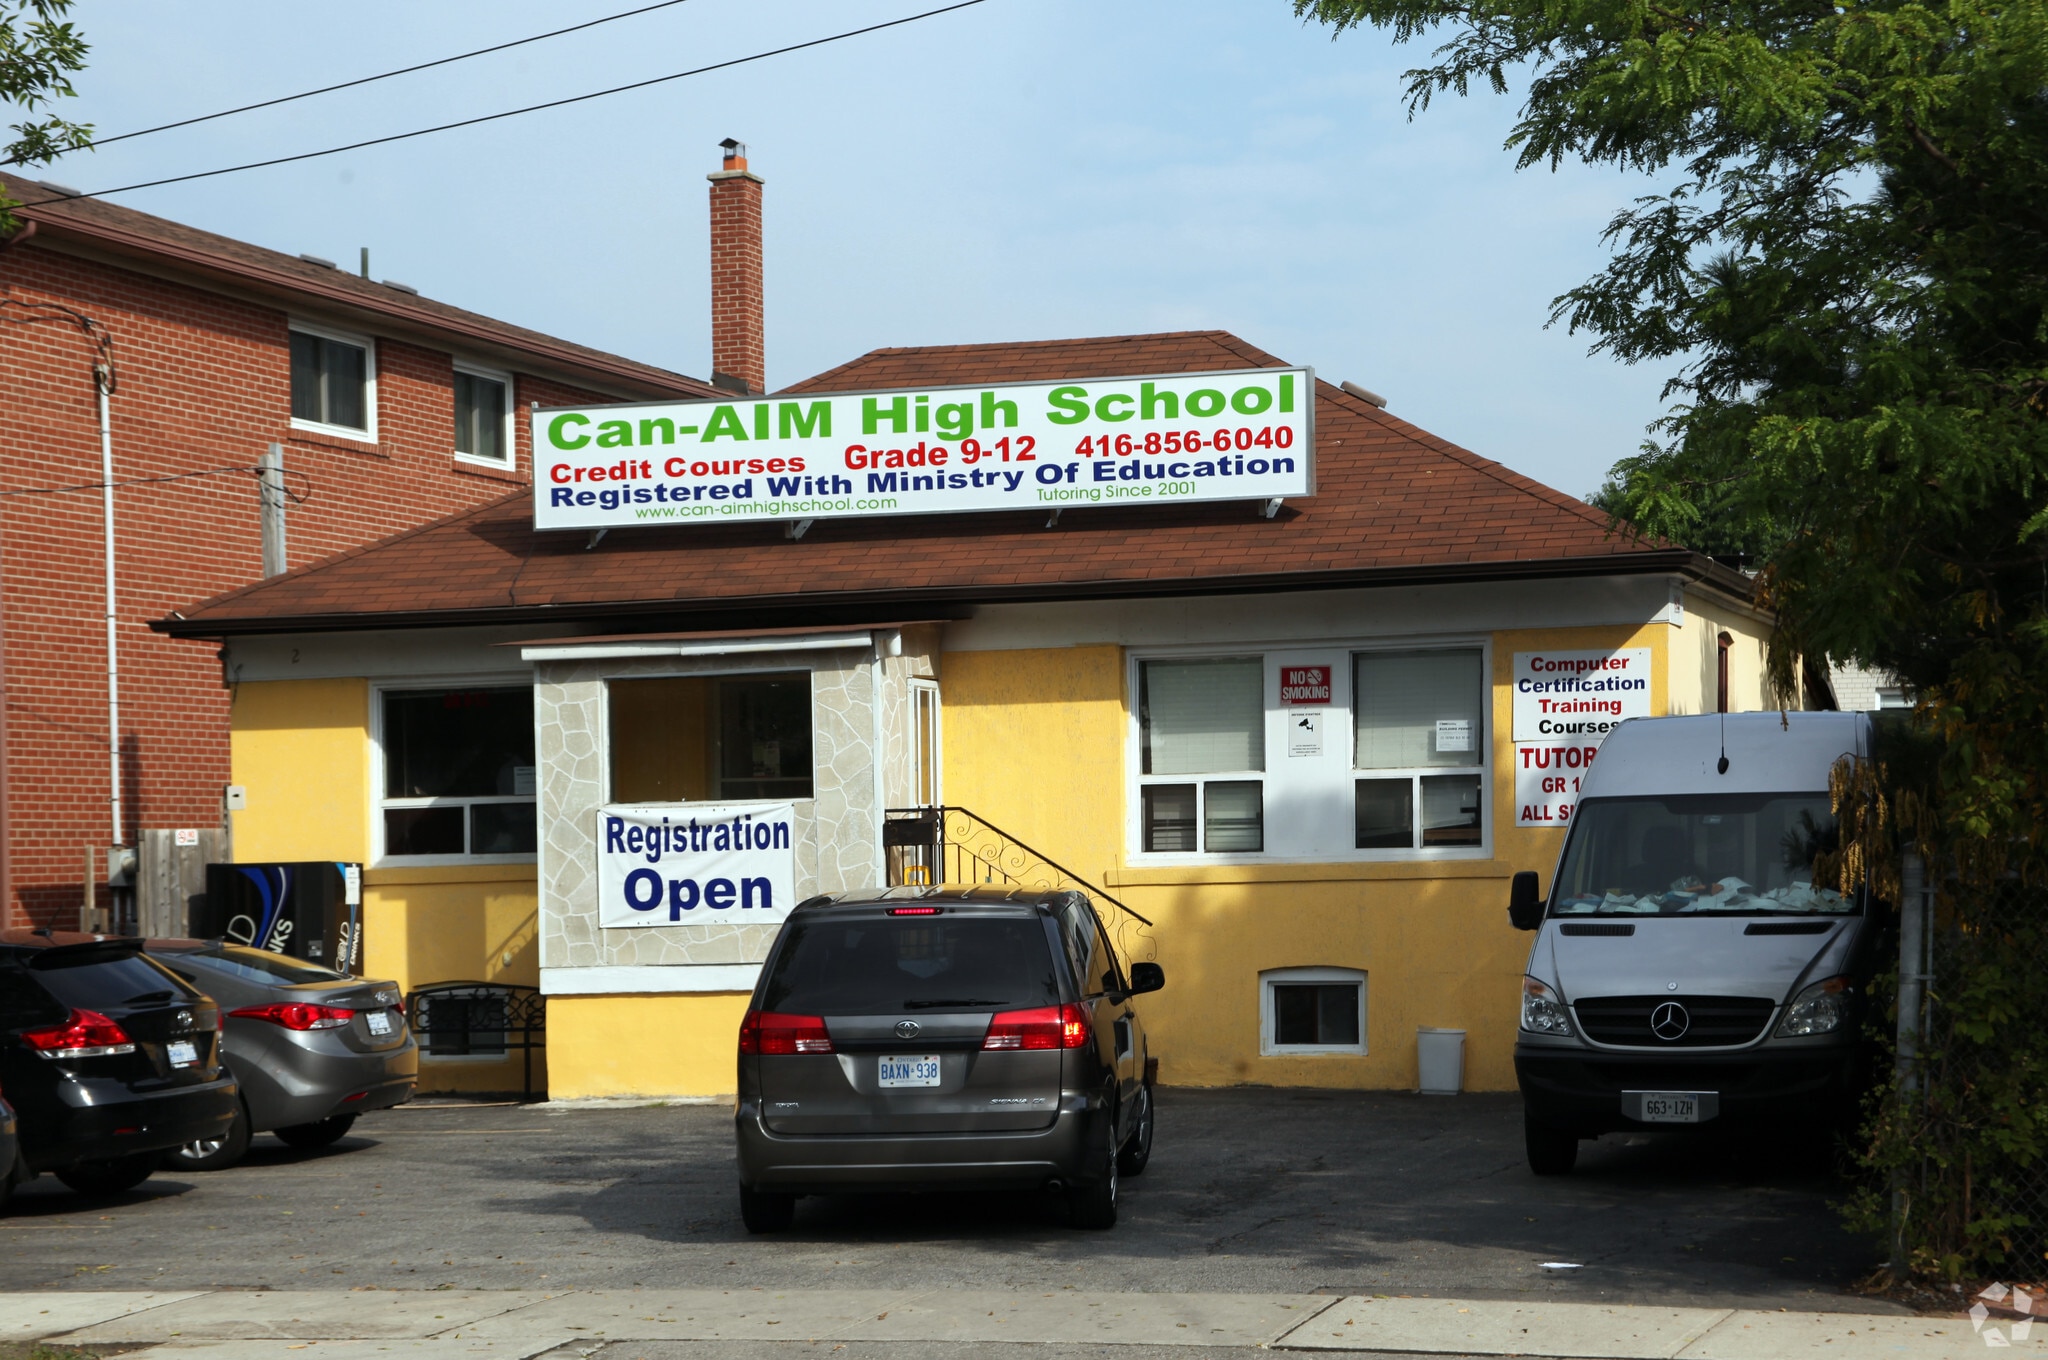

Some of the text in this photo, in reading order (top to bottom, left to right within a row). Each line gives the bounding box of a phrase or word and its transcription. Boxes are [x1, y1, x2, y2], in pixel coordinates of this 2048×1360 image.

[547, 374, 1294, 450] Can-AIM High School
[1075, 425, 1294, 458] 416-856-6040
[844, 435, 1036, 470] Grade 9-12
[549, 456, 806, 484] Credit Courses
[550, 454, 1295, 510] Registered With Ministry Of Education
[1036, 481, 1197, 502] Tutoring Since 2001
[635, 497, 898, 519] www.can-aimhighschool.com
[1530, 656, 1630, 675] Computer
[1290, 670, 1306, 685] NO
[1518, 676, 1645, 693] Certification
[1282, 685, 1329, 700] SMOKING
[1538, 698, 1622, 715] Training
[1541, 777, 1566, 793] GR
[1521, 805, 1553, 821] ALL
[606, 814, 790, 863] Registration
[623, 868, 773, 921] Open
[1647, 1100, 1693, 1116] 663 1ZH
